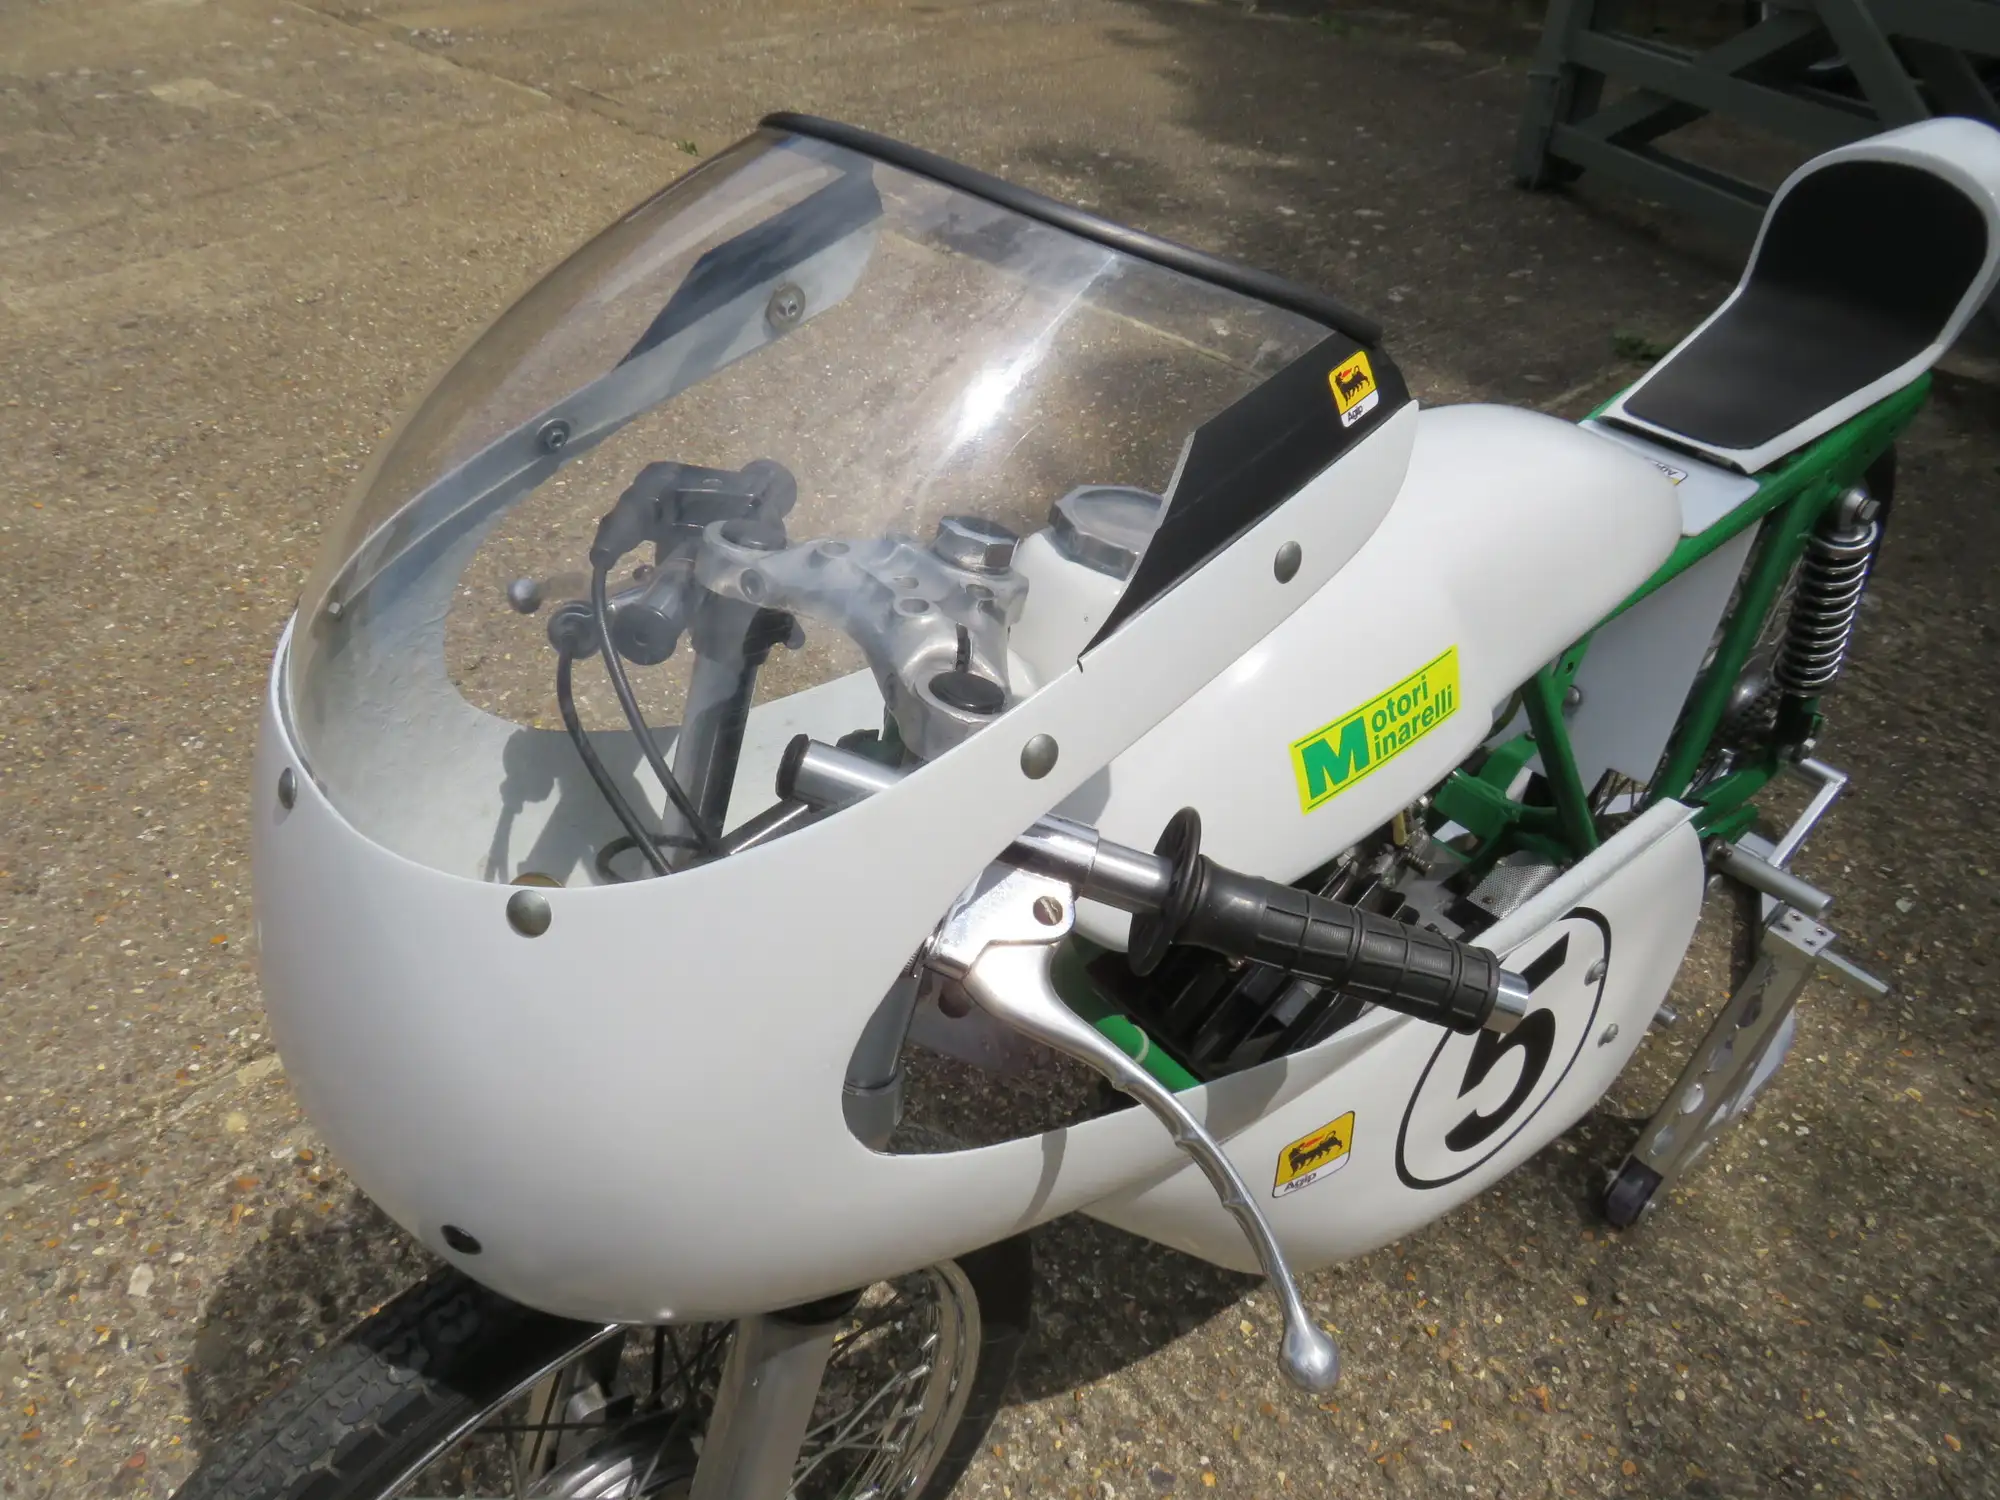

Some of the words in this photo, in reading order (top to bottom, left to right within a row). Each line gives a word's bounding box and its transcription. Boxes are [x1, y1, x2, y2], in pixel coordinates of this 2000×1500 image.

[1347, 405, 1363, 422] Agip
[1444, 931, 1571, 1152] 5
[1284, 1173, 1317, 1192] Agip
